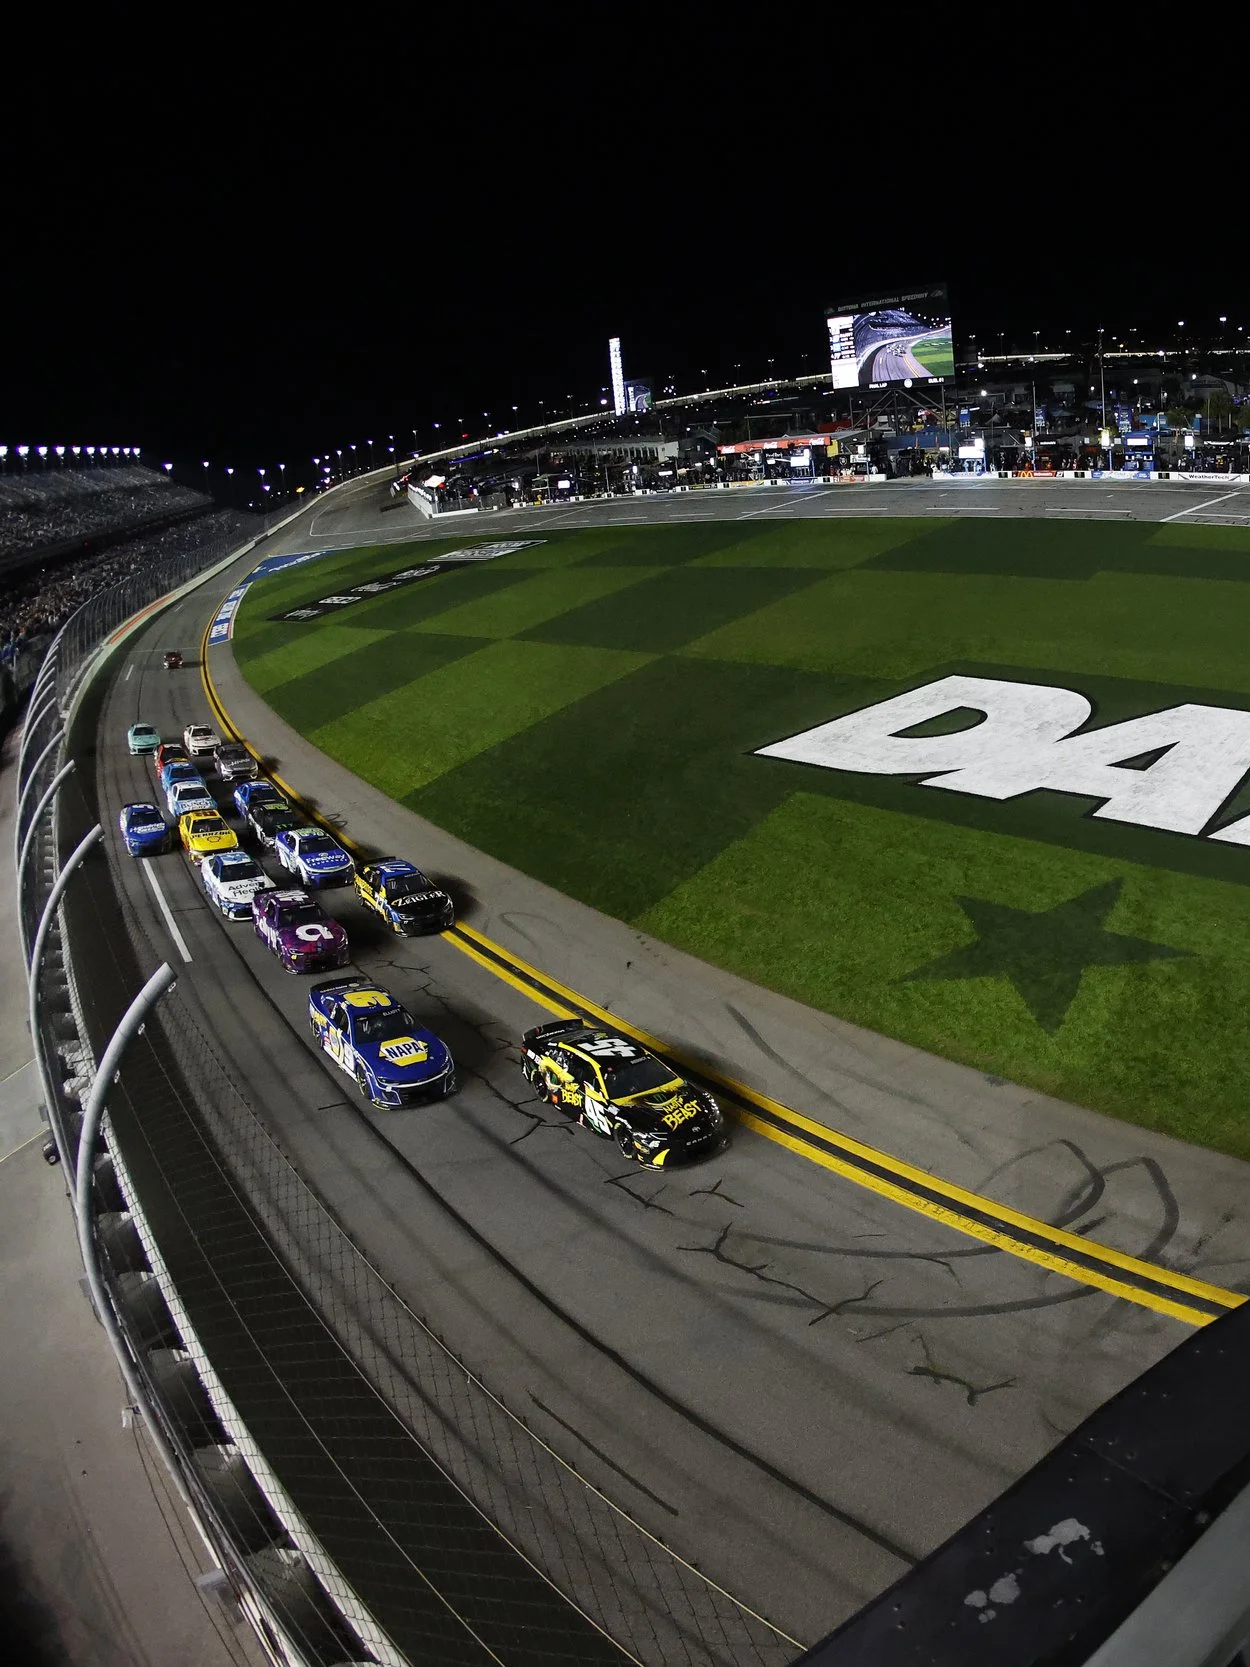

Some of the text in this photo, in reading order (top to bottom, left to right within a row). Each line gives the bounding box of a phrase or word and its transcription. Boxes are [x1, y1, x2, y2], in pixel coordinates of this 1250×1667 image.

[306, 854, 345, 864] Freeway
[391, 890, 446, 907] ZEIGLER
[382, 1008, 401, 1017] ELLIOTT
[385, 1041, 423, 1059] NAPA
[584, 1096, 611, 1136] 45
[662, 1100, 702, 1132] BEAST
